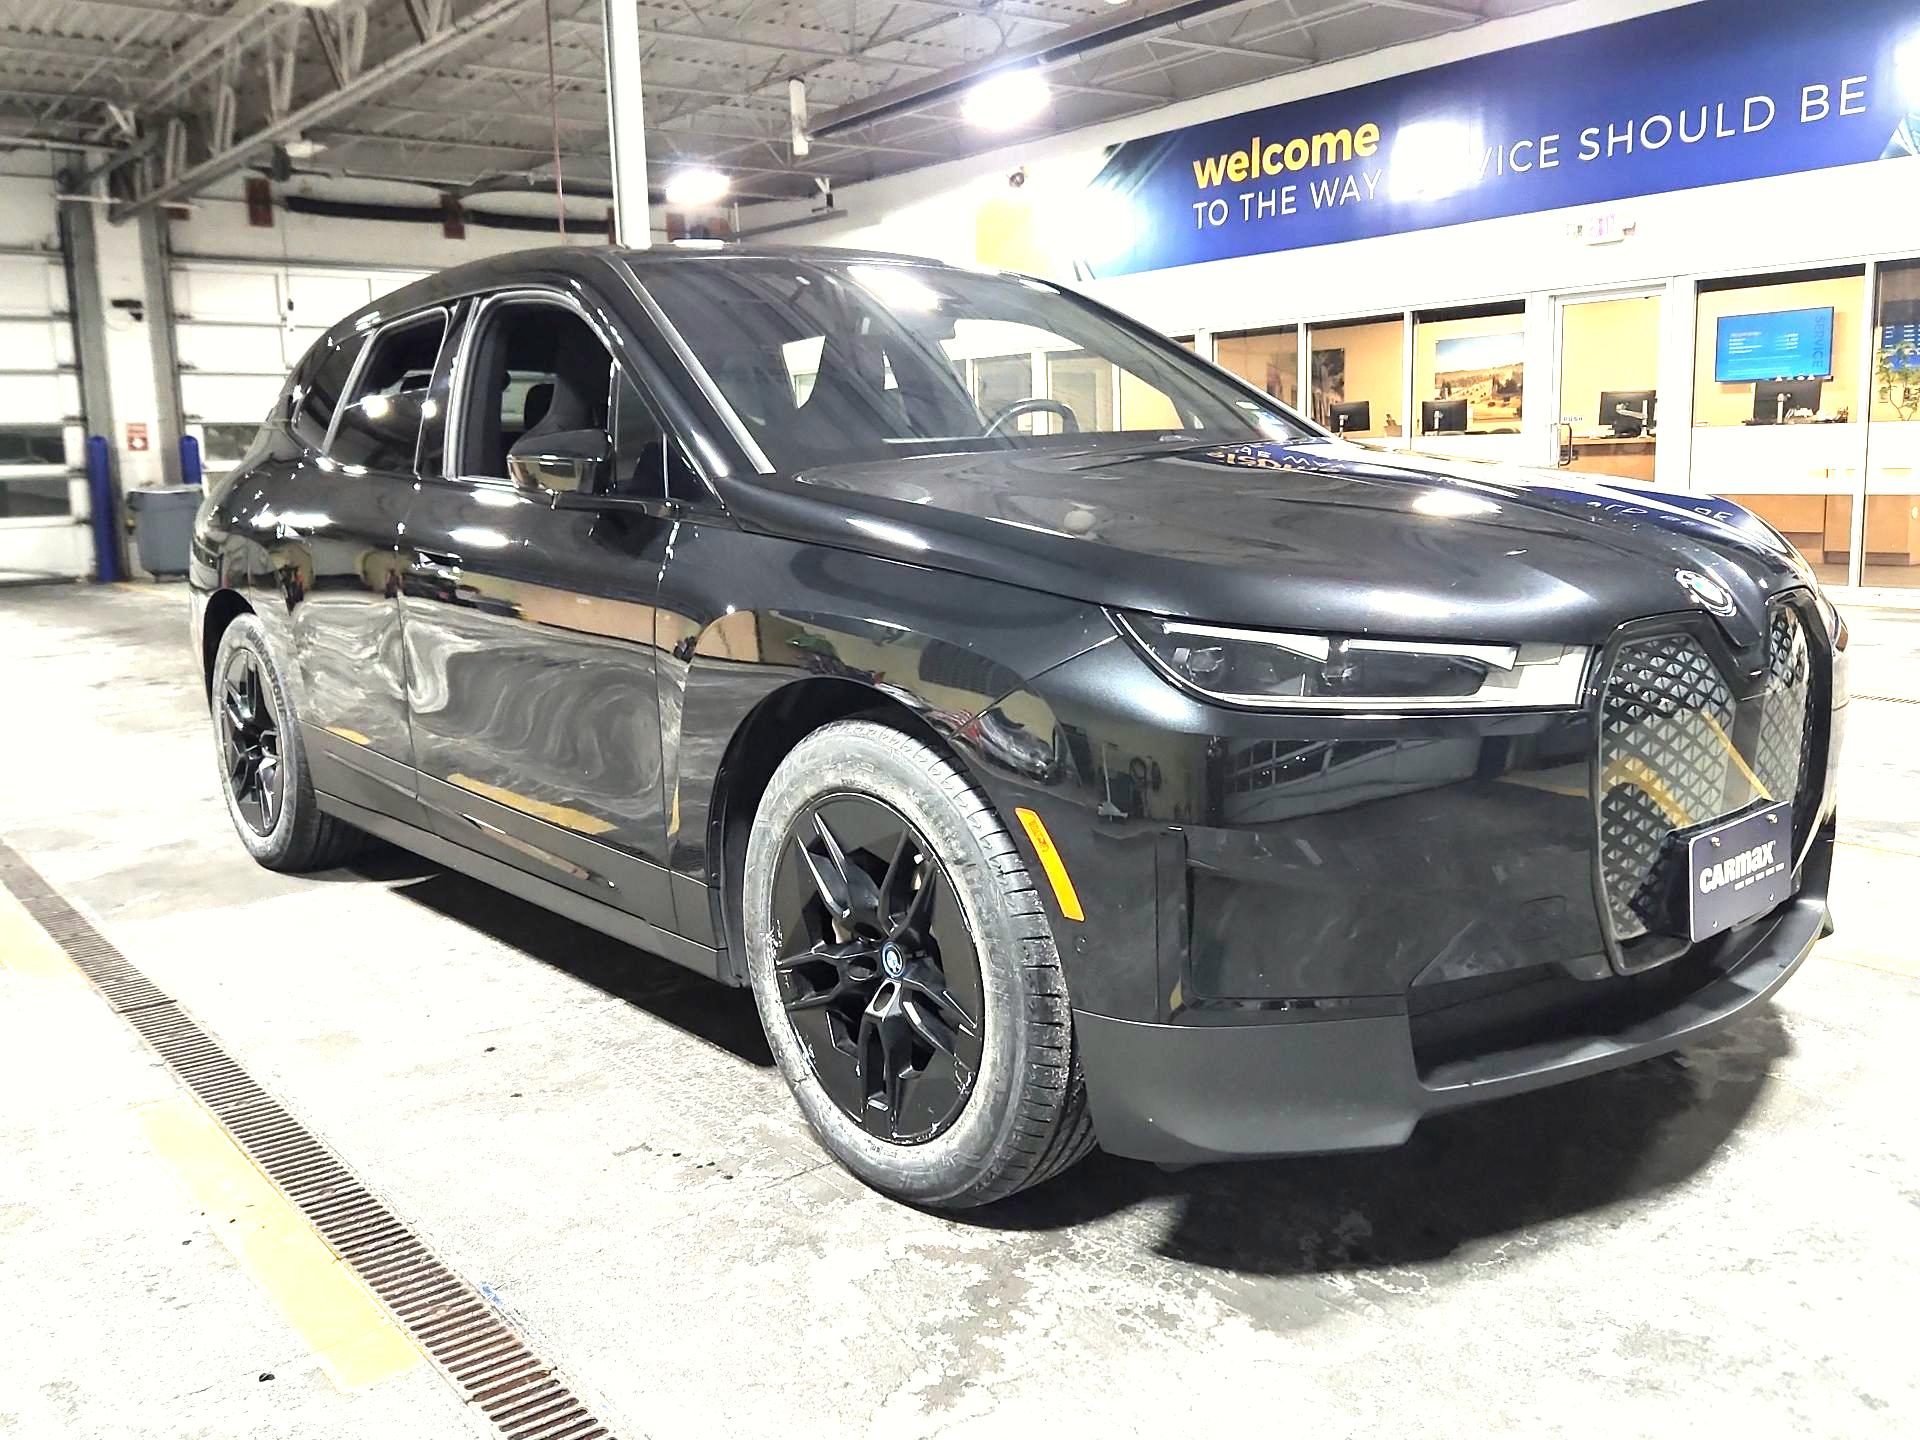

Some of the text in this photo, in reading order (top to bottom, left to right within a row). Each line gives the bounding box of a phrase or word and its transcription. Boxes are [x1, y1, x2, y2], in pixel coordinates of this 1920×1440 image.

[1193, 199, 1229, 229] TO
[1239, 185, 1297, 221] THE
[1310, 168, 1383, 209] WAY
[1578, 95, 1776, 161] SHOULD
[1800, 75, 1868, 124] BE
[1193, 122, 1380, 189] welcome
